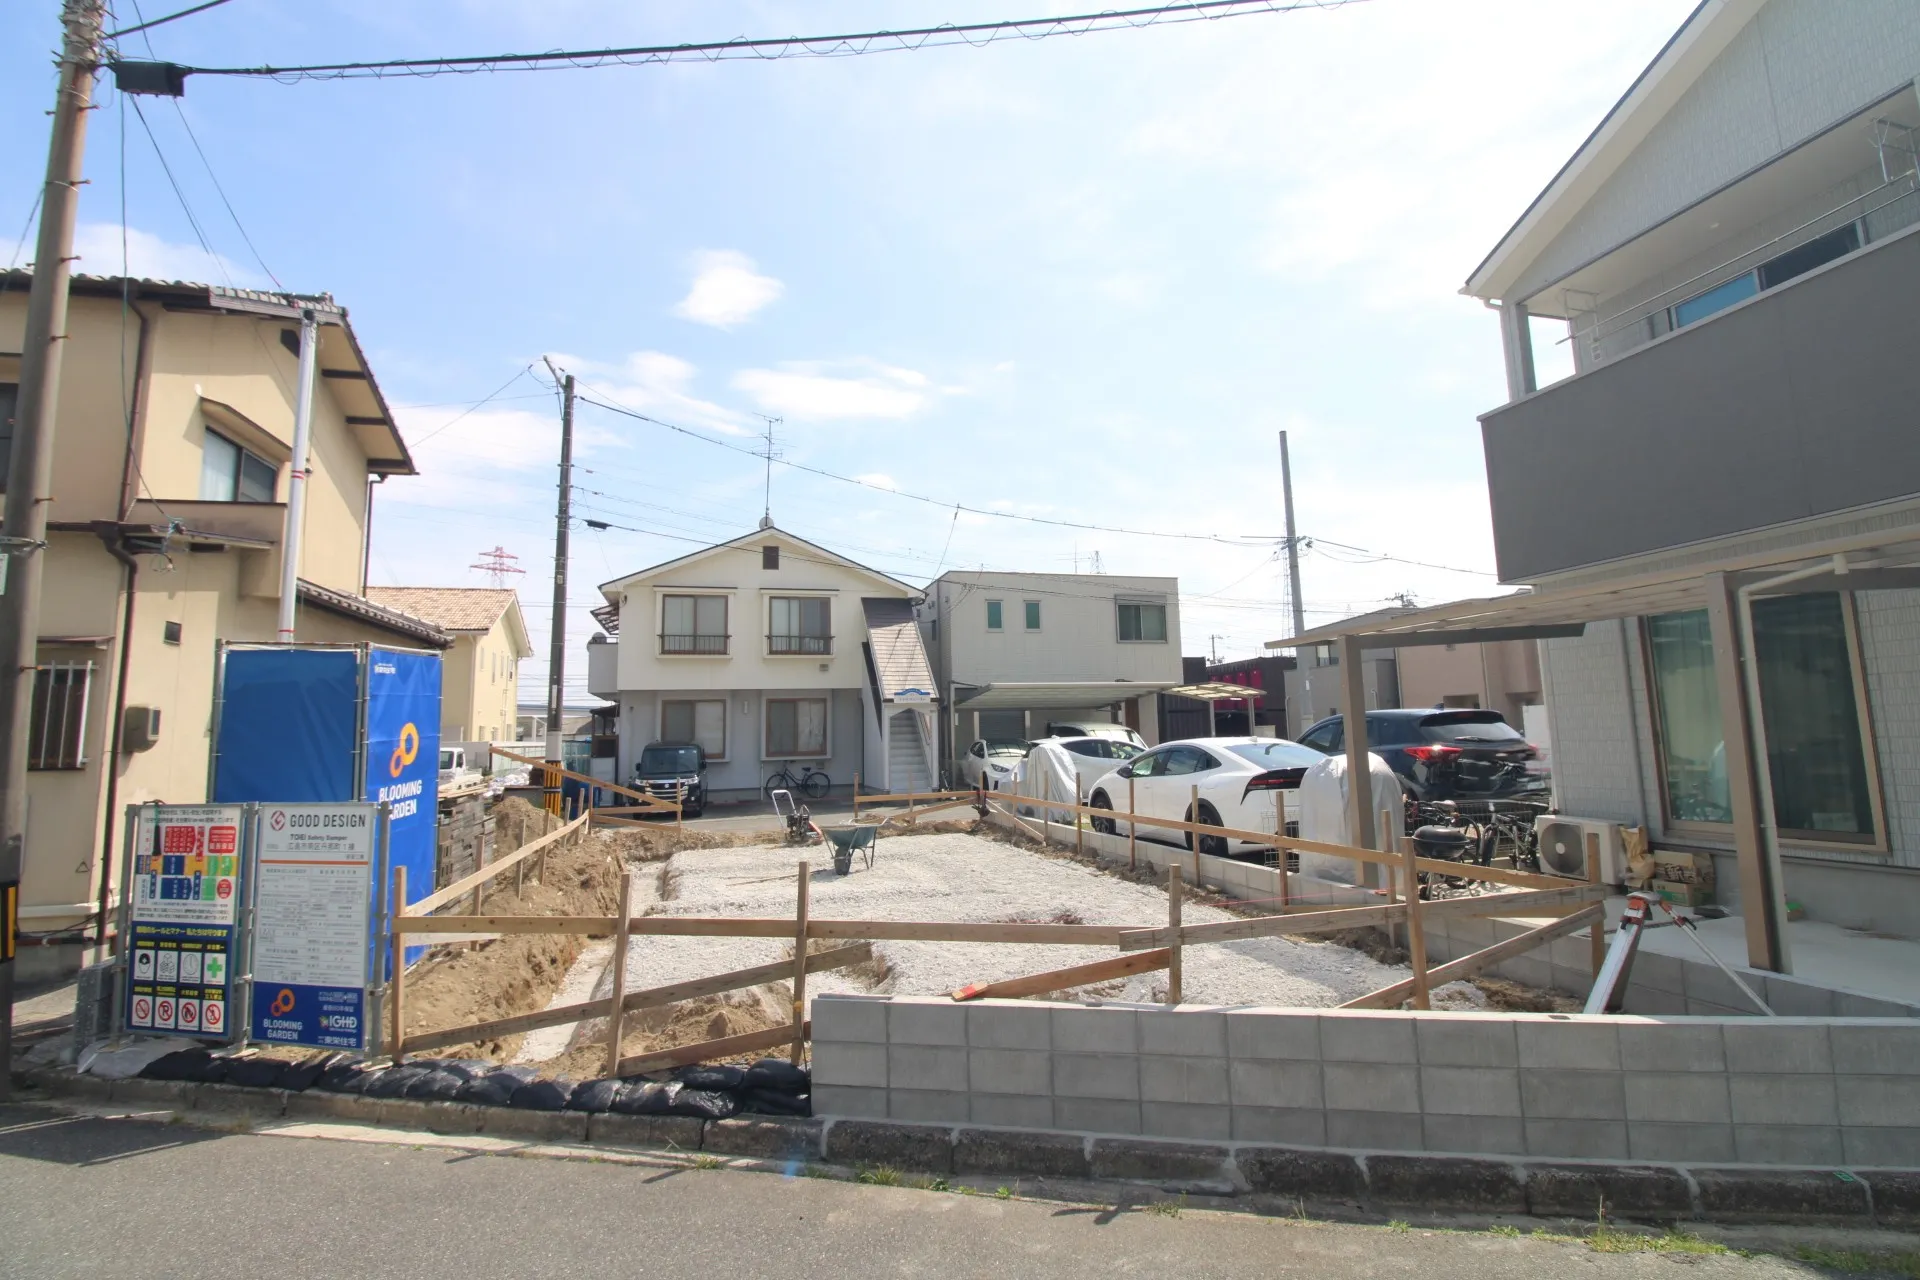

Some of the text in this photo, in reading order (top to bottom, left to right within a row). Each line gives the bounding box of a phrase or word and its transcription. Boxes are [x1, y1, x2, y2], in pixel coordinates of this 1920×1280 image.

[379, 780, 422, 804] BLOOMING
[388, 799, 417, 820] RDEN
[290, 814, 366, 828] GOOD DESIGN
[263, 1019, 303, 1030] BLOOMING
[329, 1015, 357, 1028] IGHD
[267, 1029, 298, 1040] GARDEN
